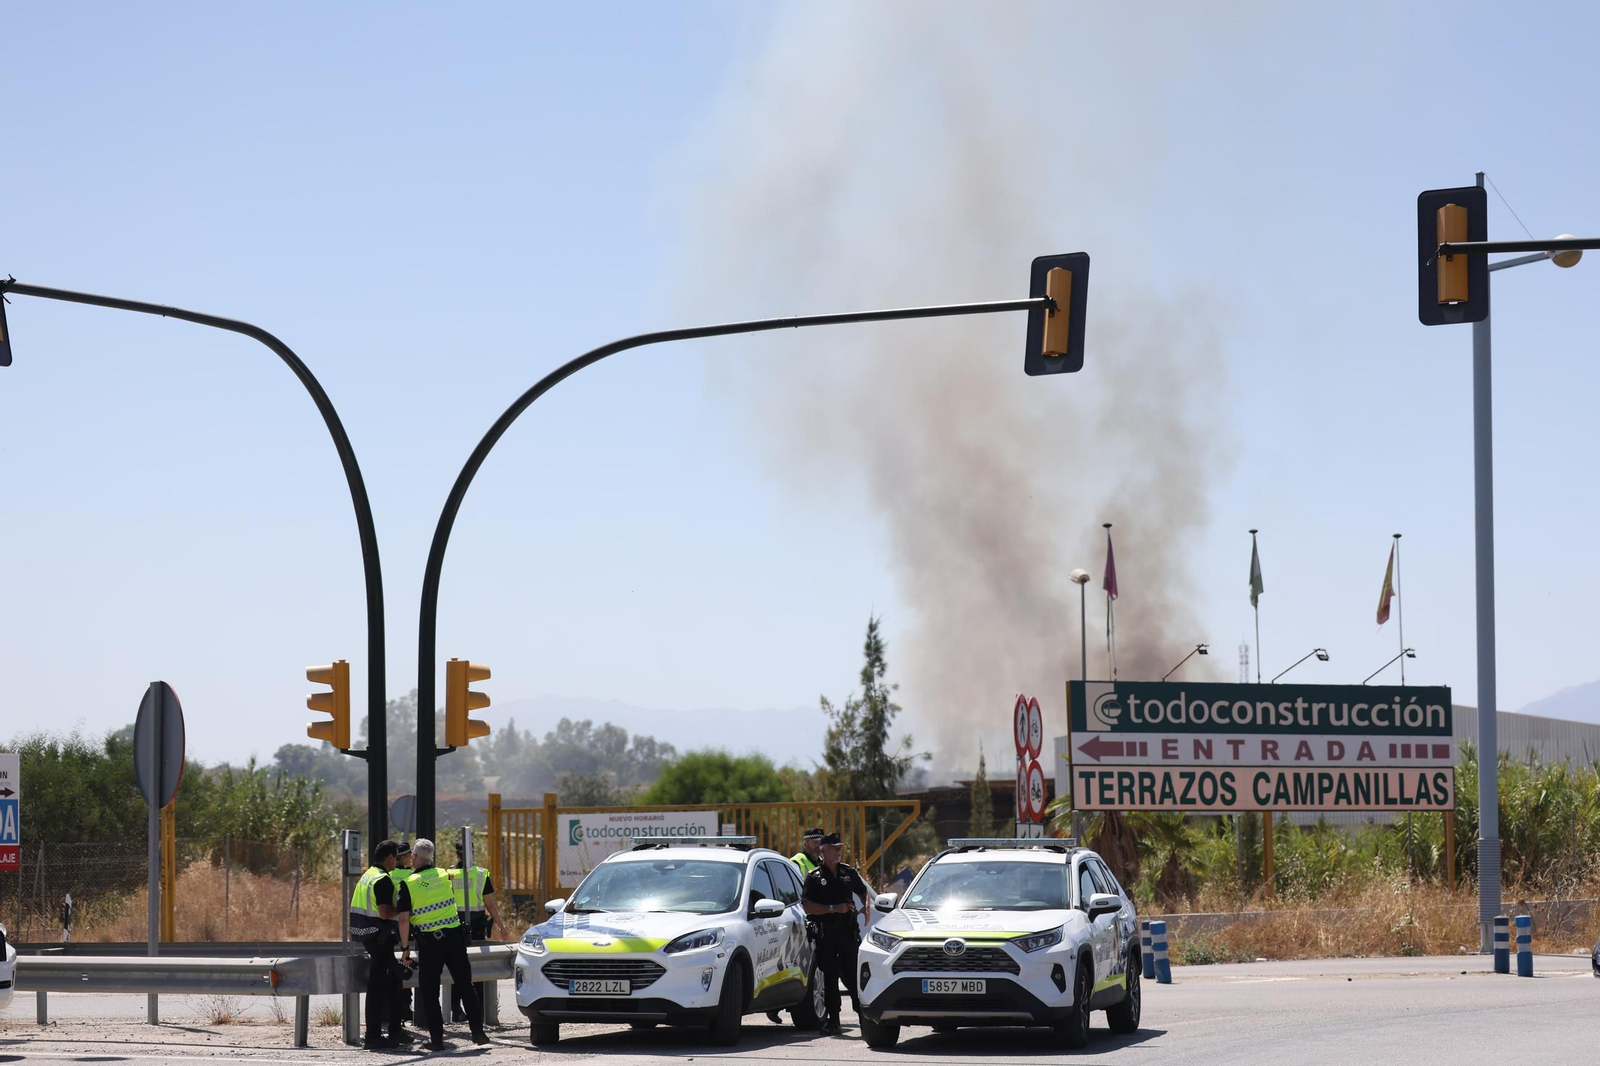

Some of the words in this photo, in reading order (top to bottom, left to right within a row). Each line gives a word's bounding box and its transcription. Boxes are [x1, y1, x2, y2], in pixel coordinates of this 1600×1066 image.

[1127, 691, 1446, 728] todoconstrucción
[1161, 739, 1377, 761] ENTRADA
[1078, 771, 1237, 806] TERRAZOS
[1252, 771, 1449, 806] CAMPANILLAS
[586, 823, 706, 838] todoconstrucción
[575, 981, 602, 992] 2822
[605, 981, 626, 992] LZL
[929, 981, 957, 992] 5857
[961, 981, 983, 992] MBD
